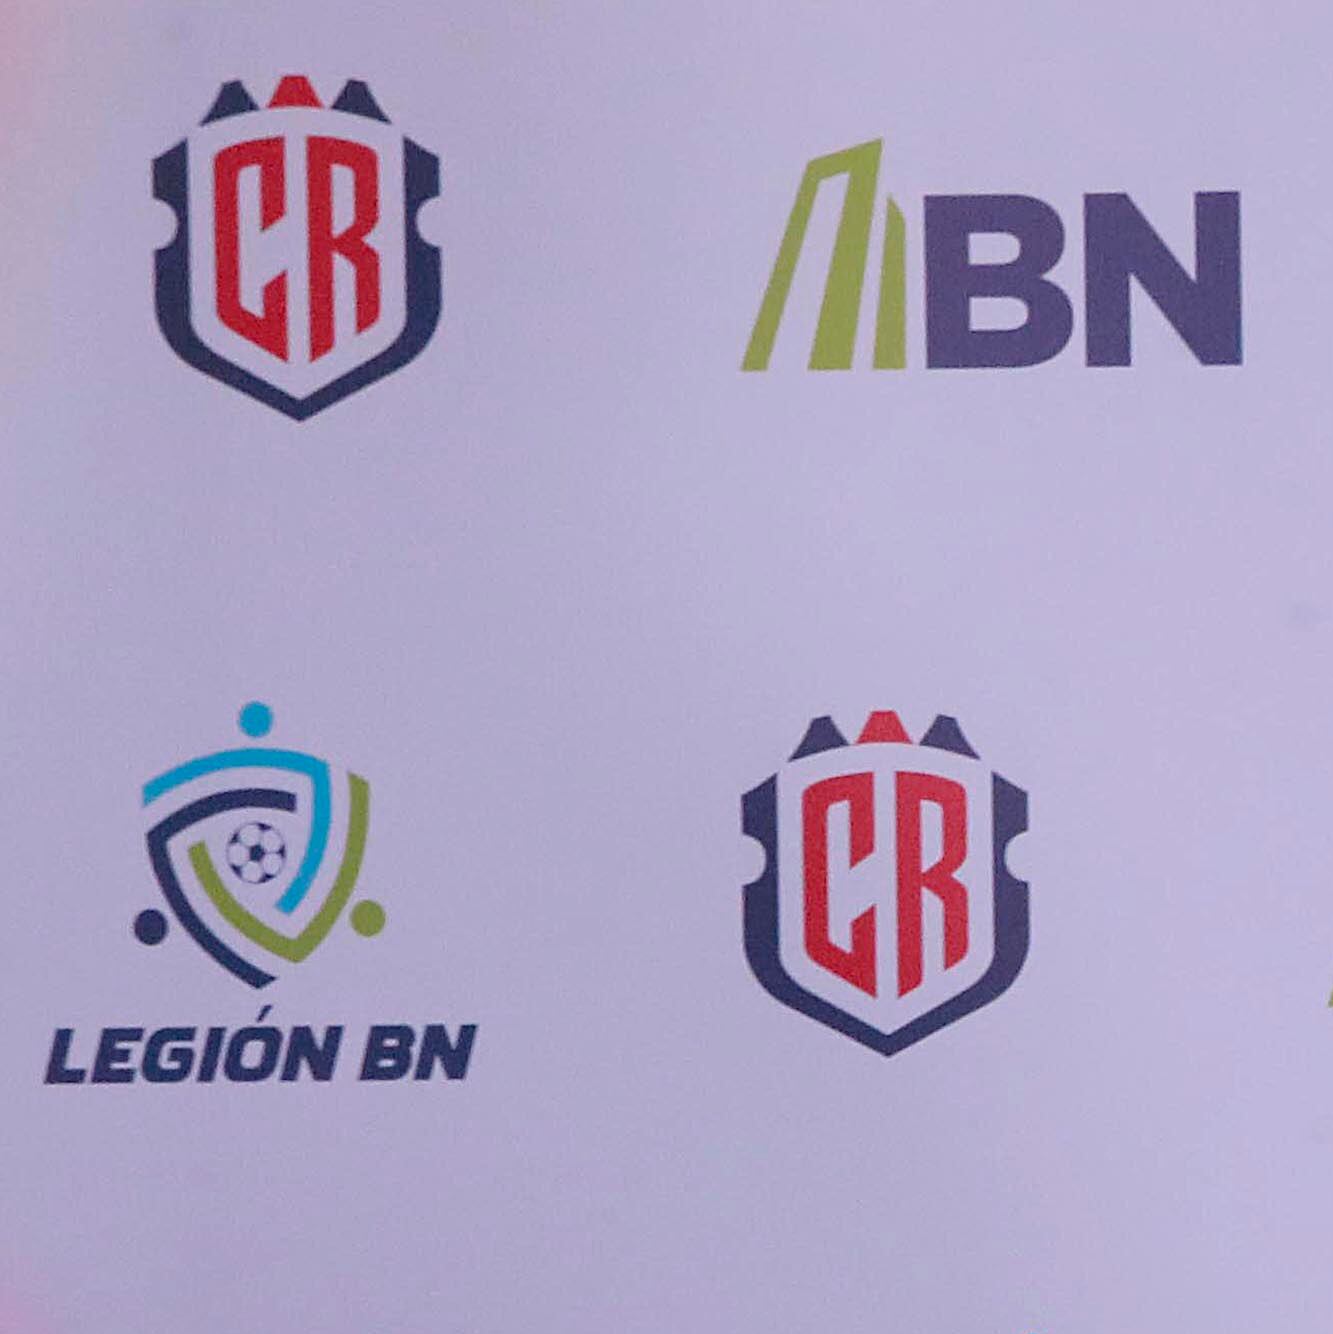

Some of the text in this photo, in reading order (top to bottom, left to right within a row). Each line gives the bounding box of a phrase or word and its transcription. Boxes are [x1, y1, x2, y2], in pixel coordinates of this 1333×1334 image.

[213, 135, 382, 362] CR
[924, 191, 1243, 369] BN
[801, 770, 970, 997] CR
[43, 1004, 479, 1085] LEGIÓN BN
